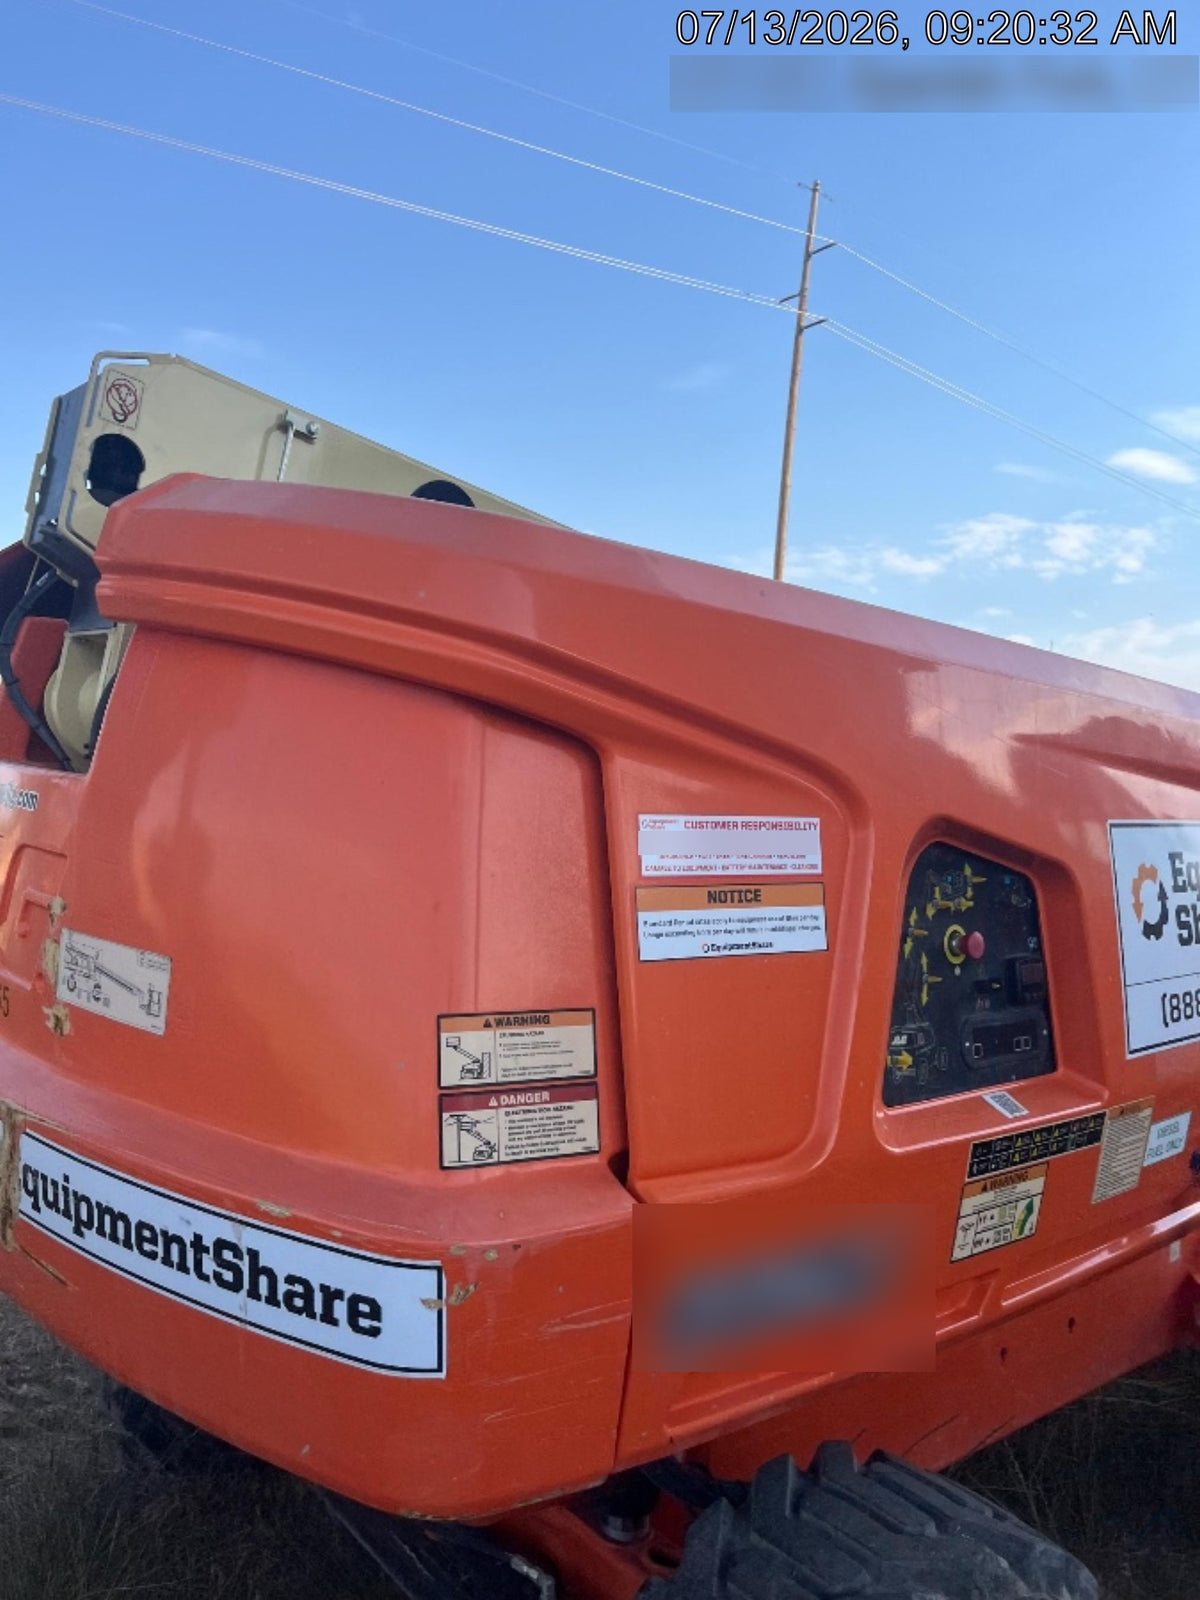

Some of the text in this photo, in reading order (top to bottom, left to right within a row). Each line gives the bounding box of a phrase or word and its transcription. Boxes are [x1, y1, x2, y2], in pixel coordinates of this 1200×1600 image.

[684, 820, 739, 831] CUSTOMER
[741, 820, 818, 832] RESPONSIBILITY
[707, 888, 762, 905] NOTICE
[495, 1014, 551, 1028] WARNING
[500, 1091, 551, 1106] DANGER
[18, 1162, 383, 1339] quipmentShare
